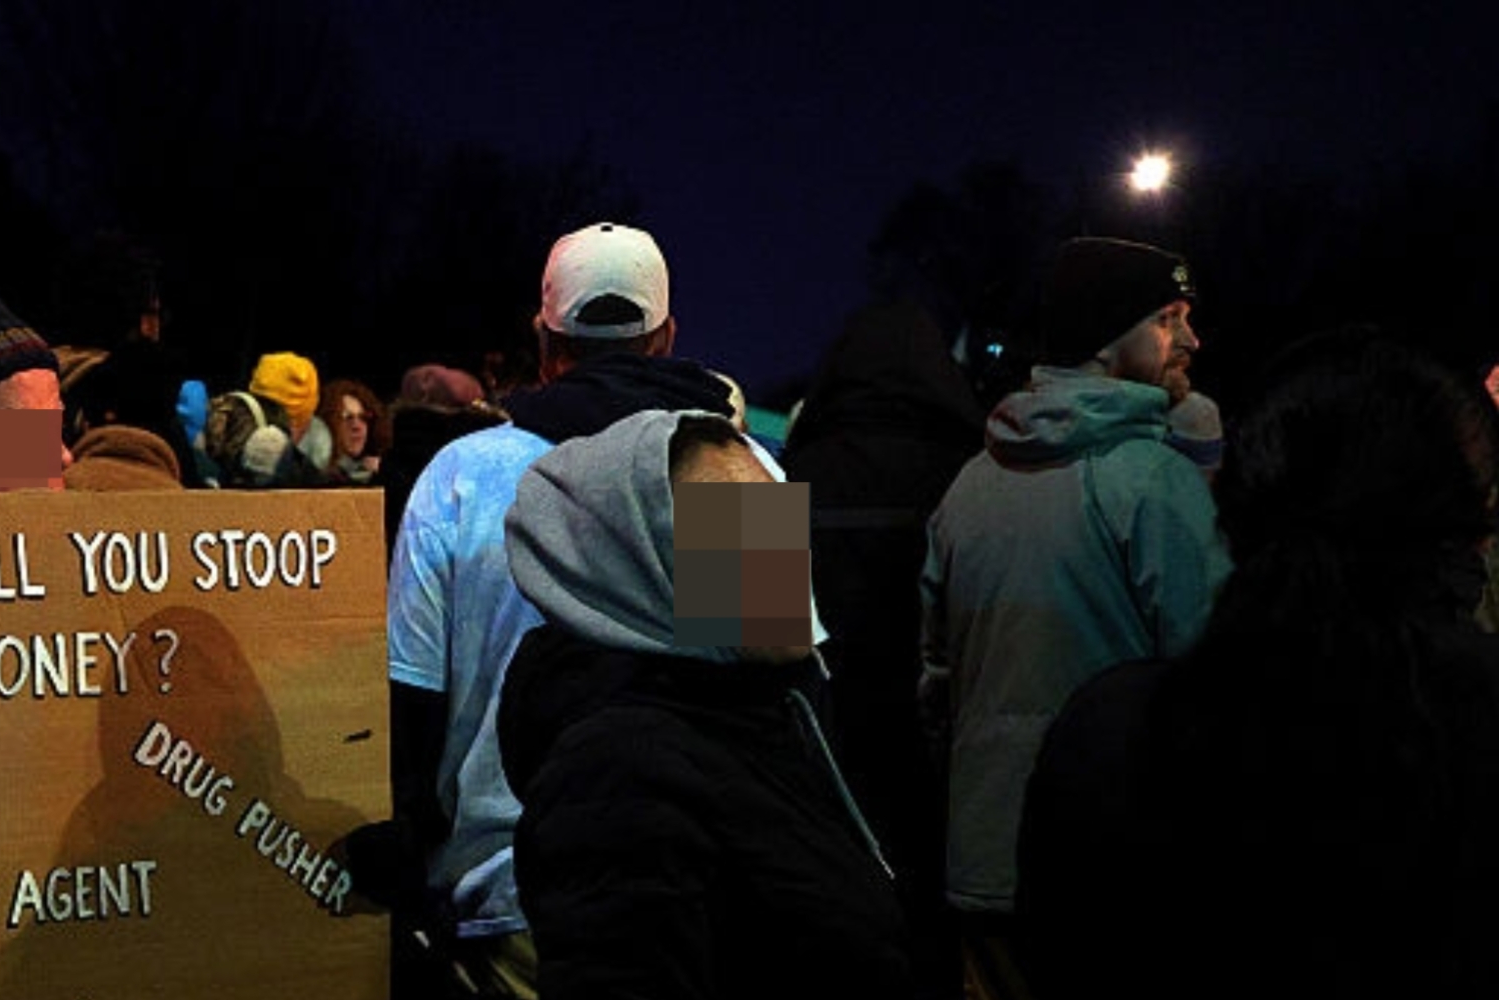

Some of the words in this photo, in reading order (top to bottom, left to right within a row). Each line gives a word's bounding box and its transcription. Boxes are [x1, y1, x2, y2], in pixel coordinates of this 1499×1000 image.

[72, 530, 170, 593] YOU
[192, 529, 338, 591] STOOP
[134, 722, 234, 816] DRUG
[238, 800, 354, 914] PUSHER
[10, 860, 157, 925] AGENT
